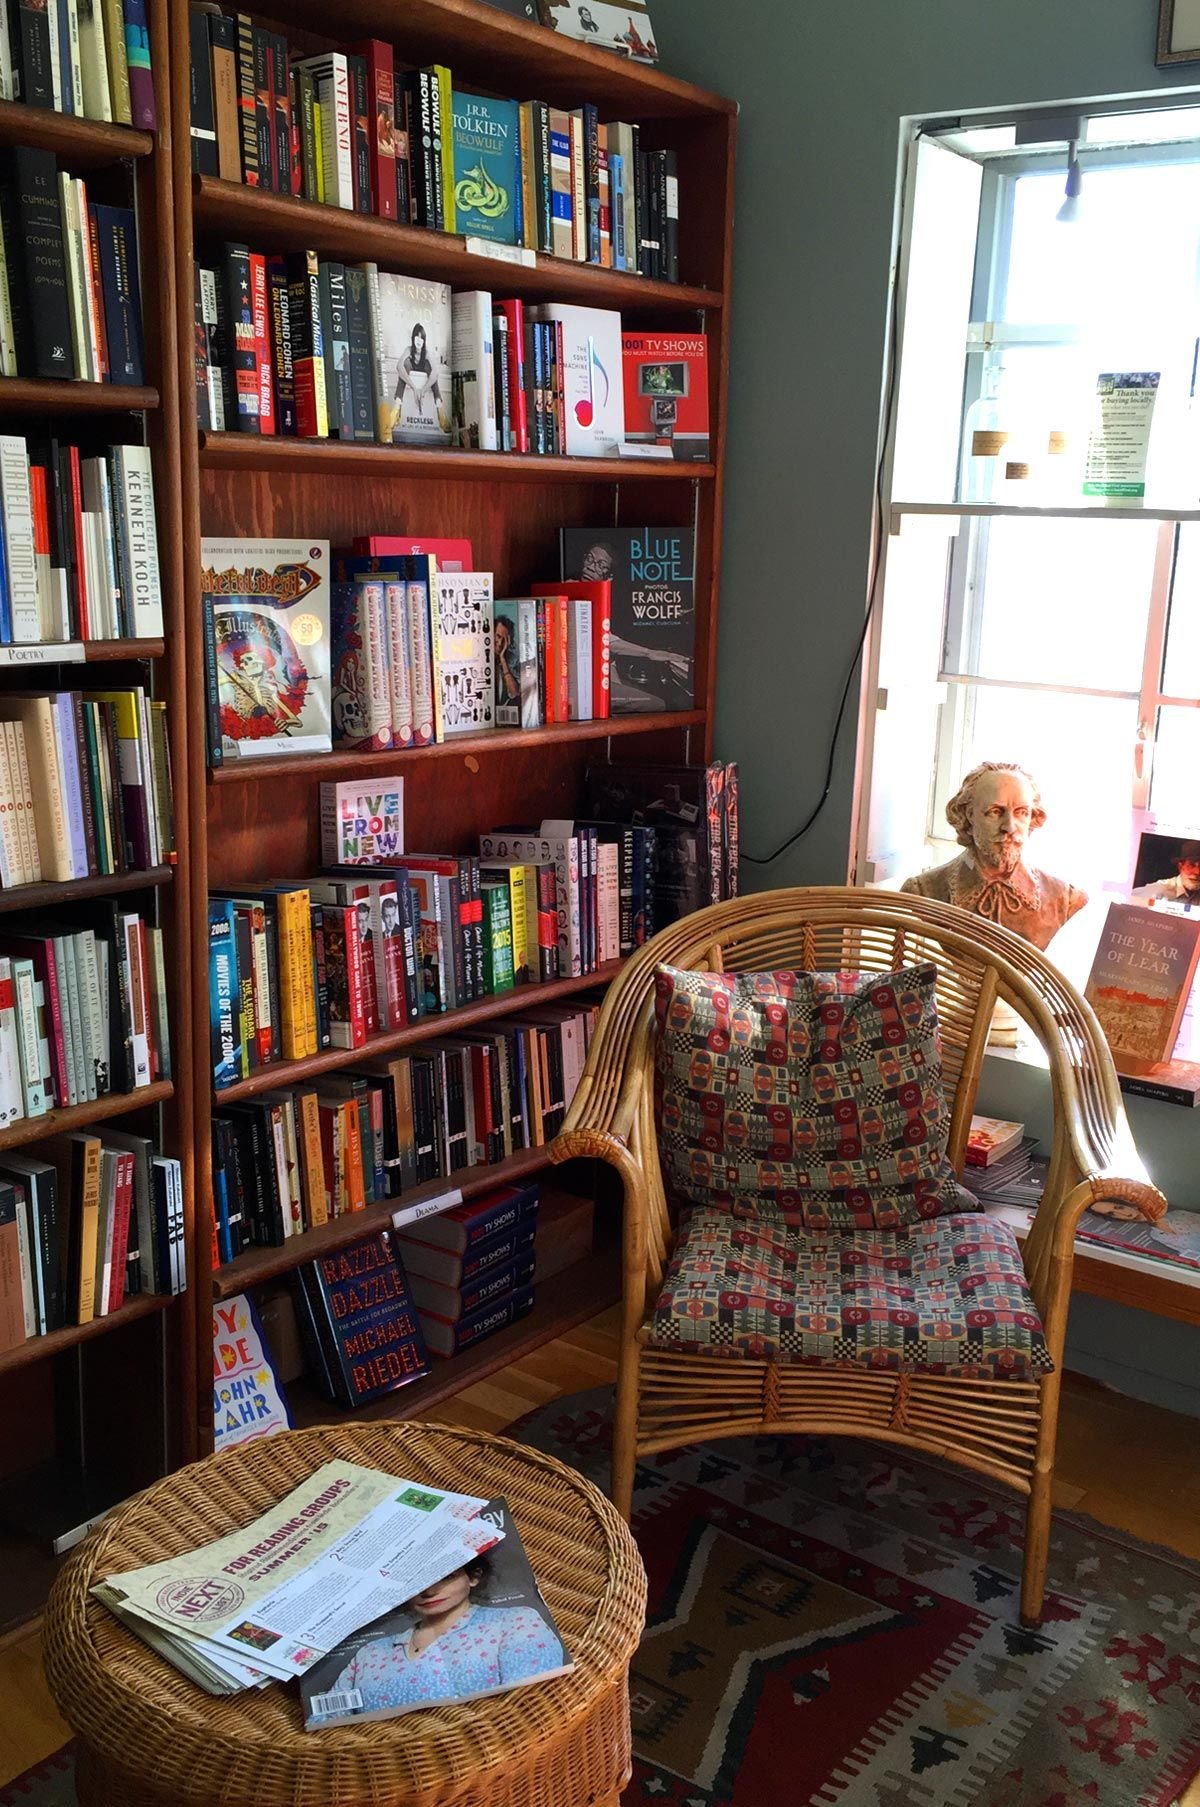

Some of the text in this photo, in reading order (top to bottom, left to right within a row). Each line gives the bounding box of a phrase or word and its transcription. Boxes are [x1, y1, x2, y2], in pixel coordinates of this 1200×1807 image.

[336, 67, 349, 150] INFERNO
[420, 73, 430, 132] BEOWULF
[431, 77, 440, 135] BEOWULF
[466, 104, 490, 118] J.R.R.
[540, 108, 548, 123] Ida
[452, 113, 508, 138] TOLKIEN
[309, 276, 321, 355] Classical Music
[330, 273, 345, 333] Miles
[255, 265, 270, 416] JERRY LEE LEWIS RICK BRAGG
[272, 288, 284, 378] ON LEONARD COHEN
[279, 289, 293, 379] LEONARD COHEN
[646, 340, 662, 350] TV
[663, 340, 704, 351] SHOWS
[1107, 397, 1129, 405] buying
[3, 450, 36, 615] JARRELL COMPLETE
[144, 495, 155, 552] COLLECTED
[127, 471, 149, 606] KENNETH KOCH
[631, 528, 680, 560] BLUE
[149, 556, 157, 589] POEMS
[631, 561, 694, 582] NOTE
[151, 594, 158, 606] OF
[632, 591, 682, 604] FRANCIS
[632, 605, 682, 619] WOLFF
[44, 719, 52, 742] MARY
[47, 747, 56, 780] OLIVER
[342, 793, 399, 819] LIVE
[342, 815, 399, 837] FROM
[6, 844, 15, 874] SONGS
[22, 841, 31, 870] SONGS
[31, 839, 39, 869] SONGS
[343, 832, 399, 858] NEW
[624, 831, 633, 874] KEEPERS
[712, 847, 721, 871] TREK
[730, 845, 738, 869] TREK
[85, 936, 94, 955] THE
[404, 928, 415, 976] DOCTOR WHO
[1110, 931, 1178, 961] THE YEAR
[87, 959, 96, 979] BEST
[216, 955, 230, 996] MOVIES
[1107, 950, 1170, 976] OF LEAR
[89, 983, 97, 994] OF
[219, 999, 231, 1011] OF
[246, 998, 254, 1039] LEONARD
[220, 1014, 232, 1032] THE
[221, 1036, 234, 1069] 2000s
[66, 1058, 74, 1083] FACTS
[75, 1055, 85, 1080] FACTS
[350, 1131, 359, 1165] IBSEN
[374, 1141, 384, 1175] Ibsen
[168, 1215, 176, 1244] PAD
[484, 1222, 493, 1232] TV
[494, 1209, 516, 1228] SHOWS
[322, 1232, 396, 1285] RAZZLE
[480, 1242, 511, 1266] TV SHOWS
[330, 1268, 405, 1320] DAZZLE
[480, 1274, 511, 1297] TV SHOWS
[339, 1299, 408, 1331] THE BATTLE FOR BROADWAY
[474, 1308, 508, 1333] TV SHOWS
[343, 1314, 417, 1359] MICHAEL
[352, 1342, 425, 1393] RIEDEL
[224, 1556, 255, 1575] FOR
[248, 1517, 307, 1557] READING
[300, 1479, 351, 1517] GROUPS
[249, 1537, 312, 1582] SUMMER
[329, 1553, 344, 1561] 2
[379, 1569, 390, 1577] 4
[171, 1585, 193, 1601] INDIE
[175, 1579, 225, 1618] NEXT
[212, 1596, 230, 1611] LIST
[300, 1633, 316, 1641] 3
